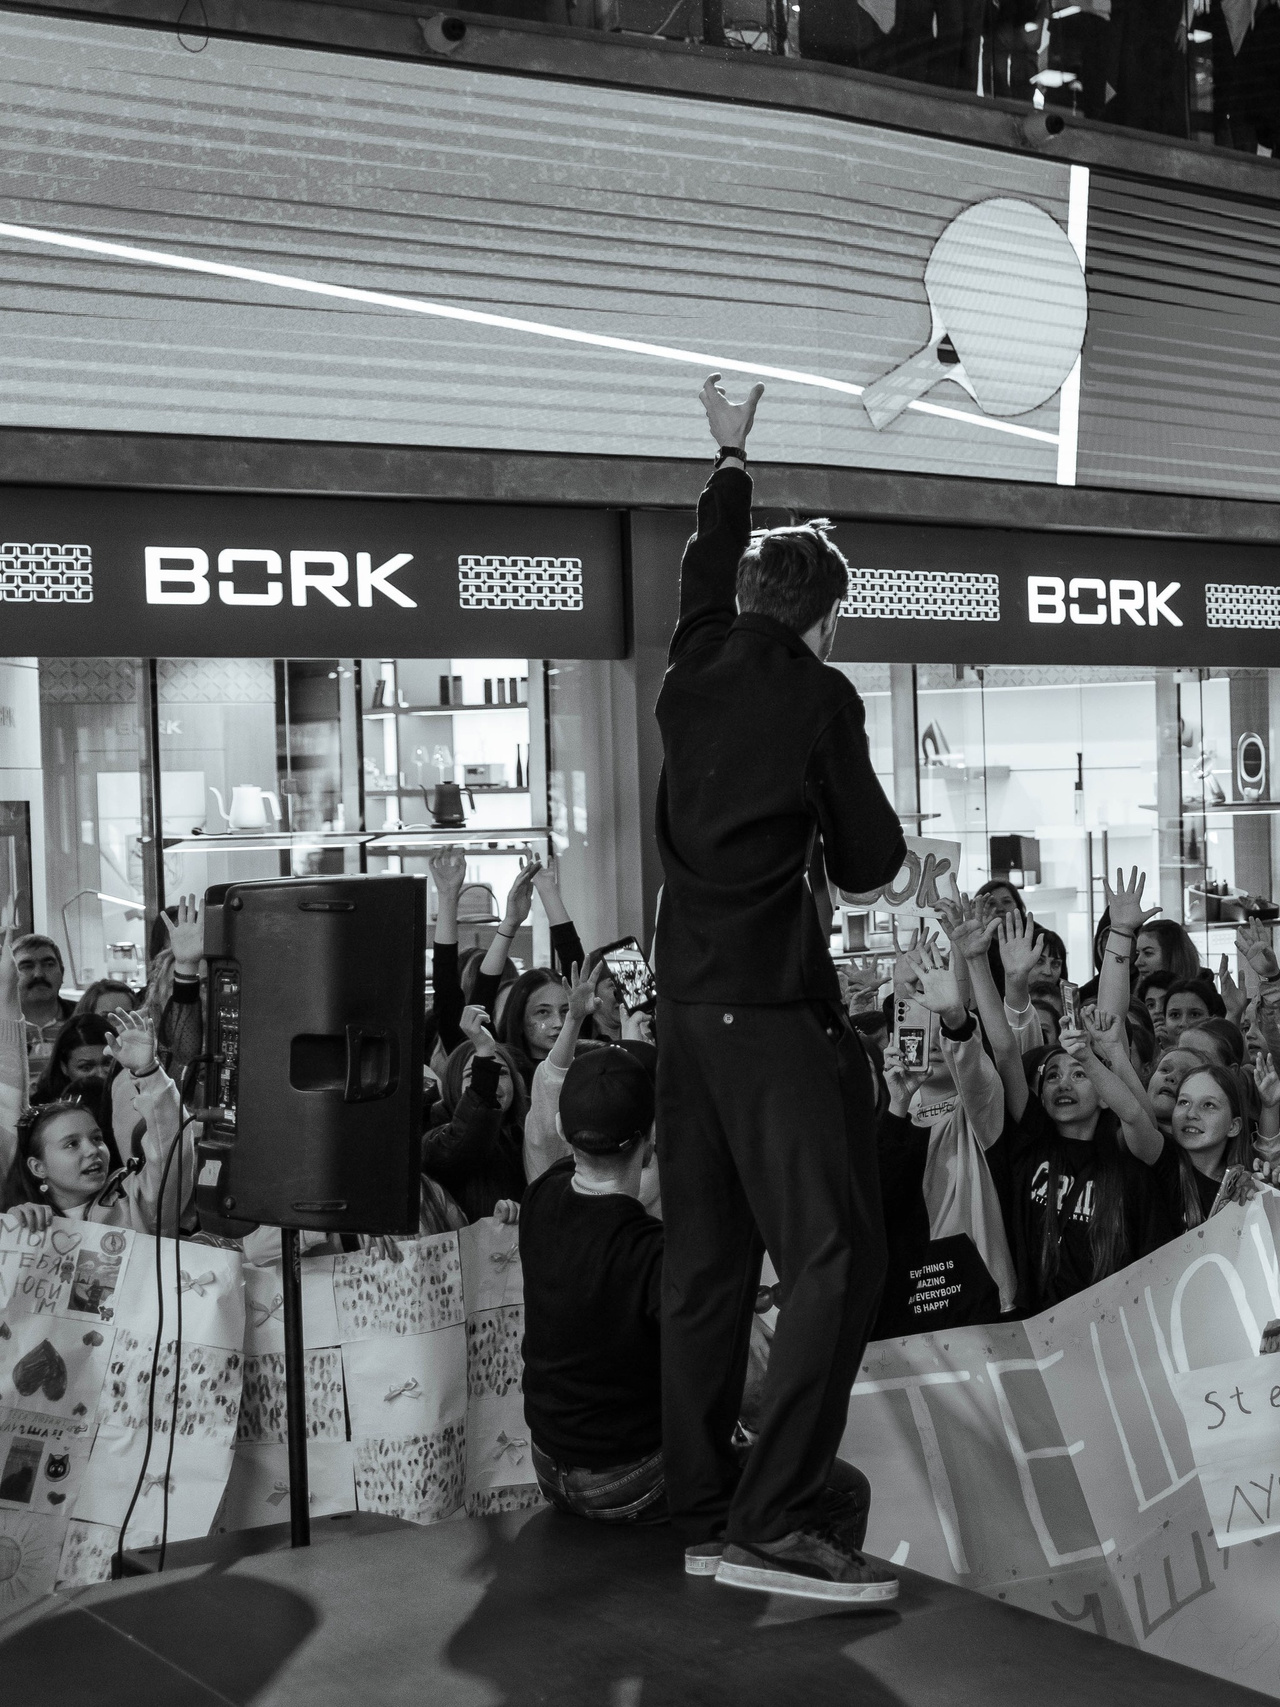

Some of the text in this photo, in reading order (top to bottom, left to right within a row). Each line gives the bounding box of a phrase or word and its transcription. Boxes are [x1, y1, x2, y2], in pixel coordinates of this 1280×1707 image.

[144, 546, 418, 608] BORK
[1027, 575, 1184, 627] BORK
[840, 849, 951, 908] OK
[946, 1261, 954, 1269] IS
[913, 1305, 922, 1314] IS
[922, 1299, 950, 1312] HAPPY
[916, 1284, 961, 1301] EVERYBODY
